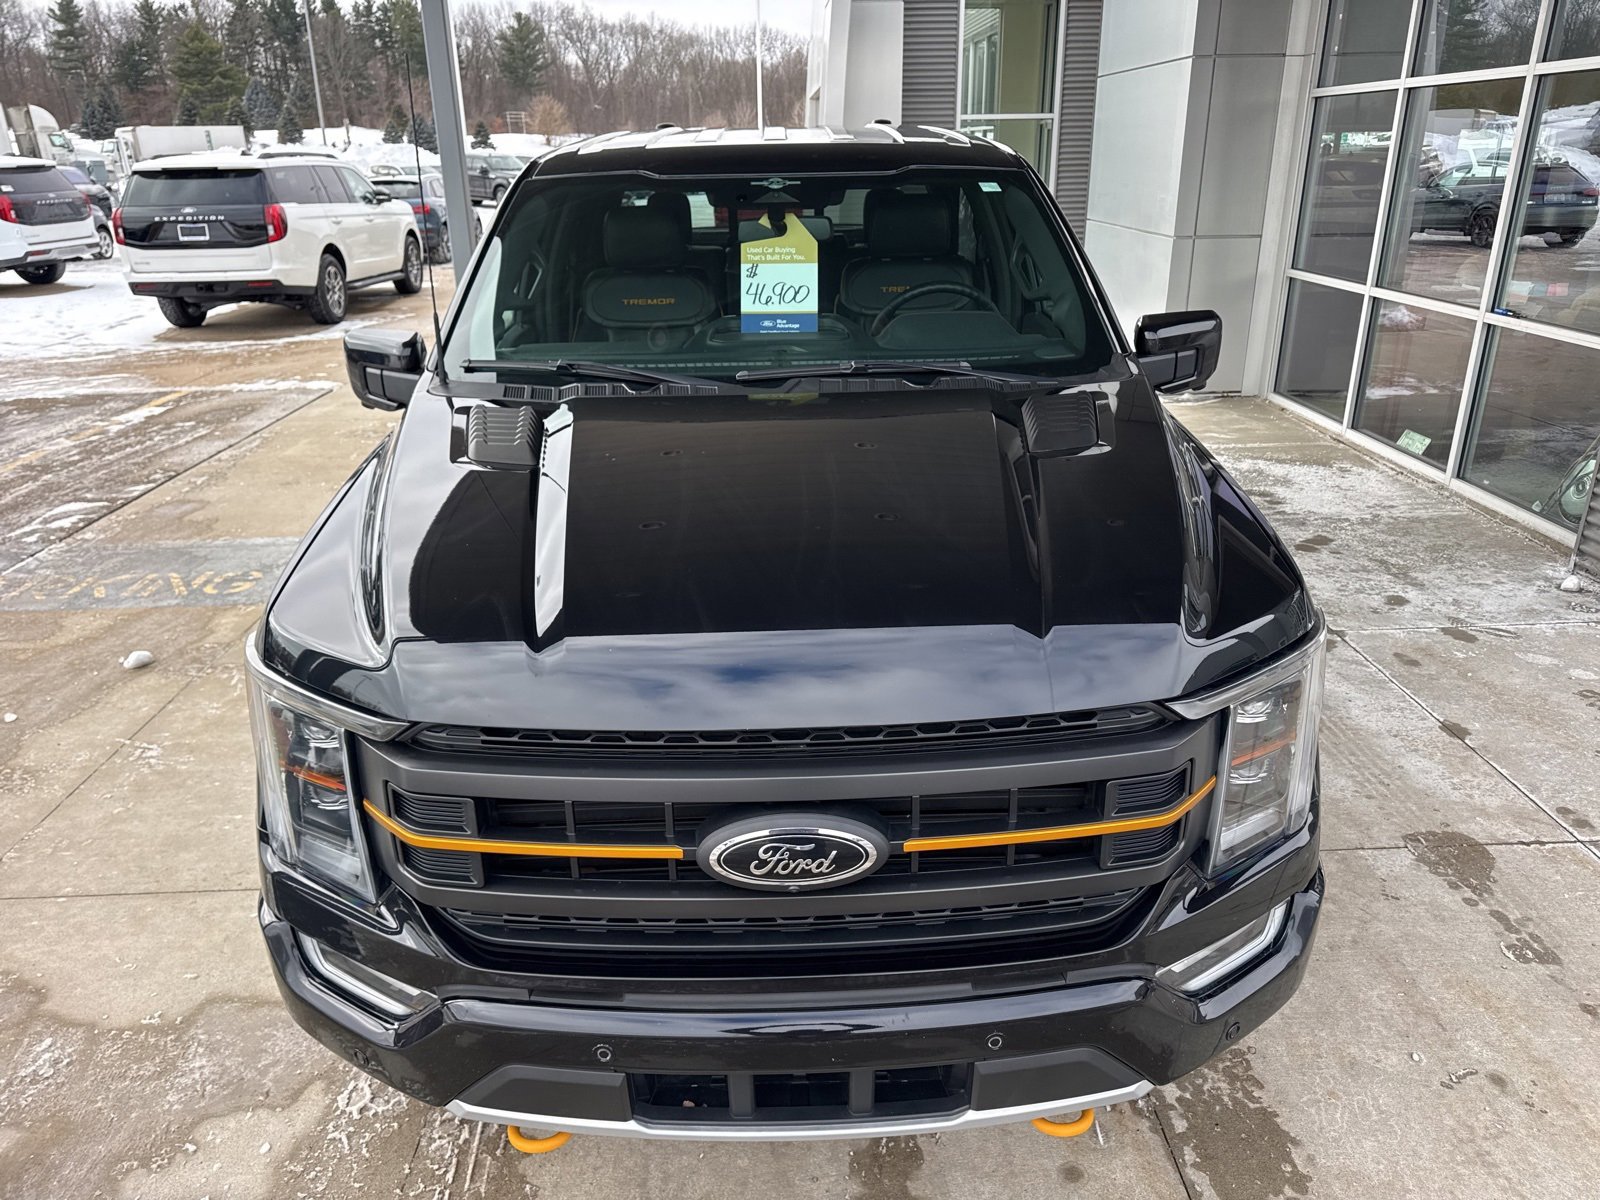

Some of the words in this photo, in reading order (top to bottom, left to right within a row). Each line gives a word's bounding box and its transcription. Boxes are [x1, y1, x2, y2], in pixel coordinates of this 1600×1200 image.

[745, 263, 759, 279] $
[622, 297, 676, 305] TREMOR
[749, 842, 838, 876] Ford
